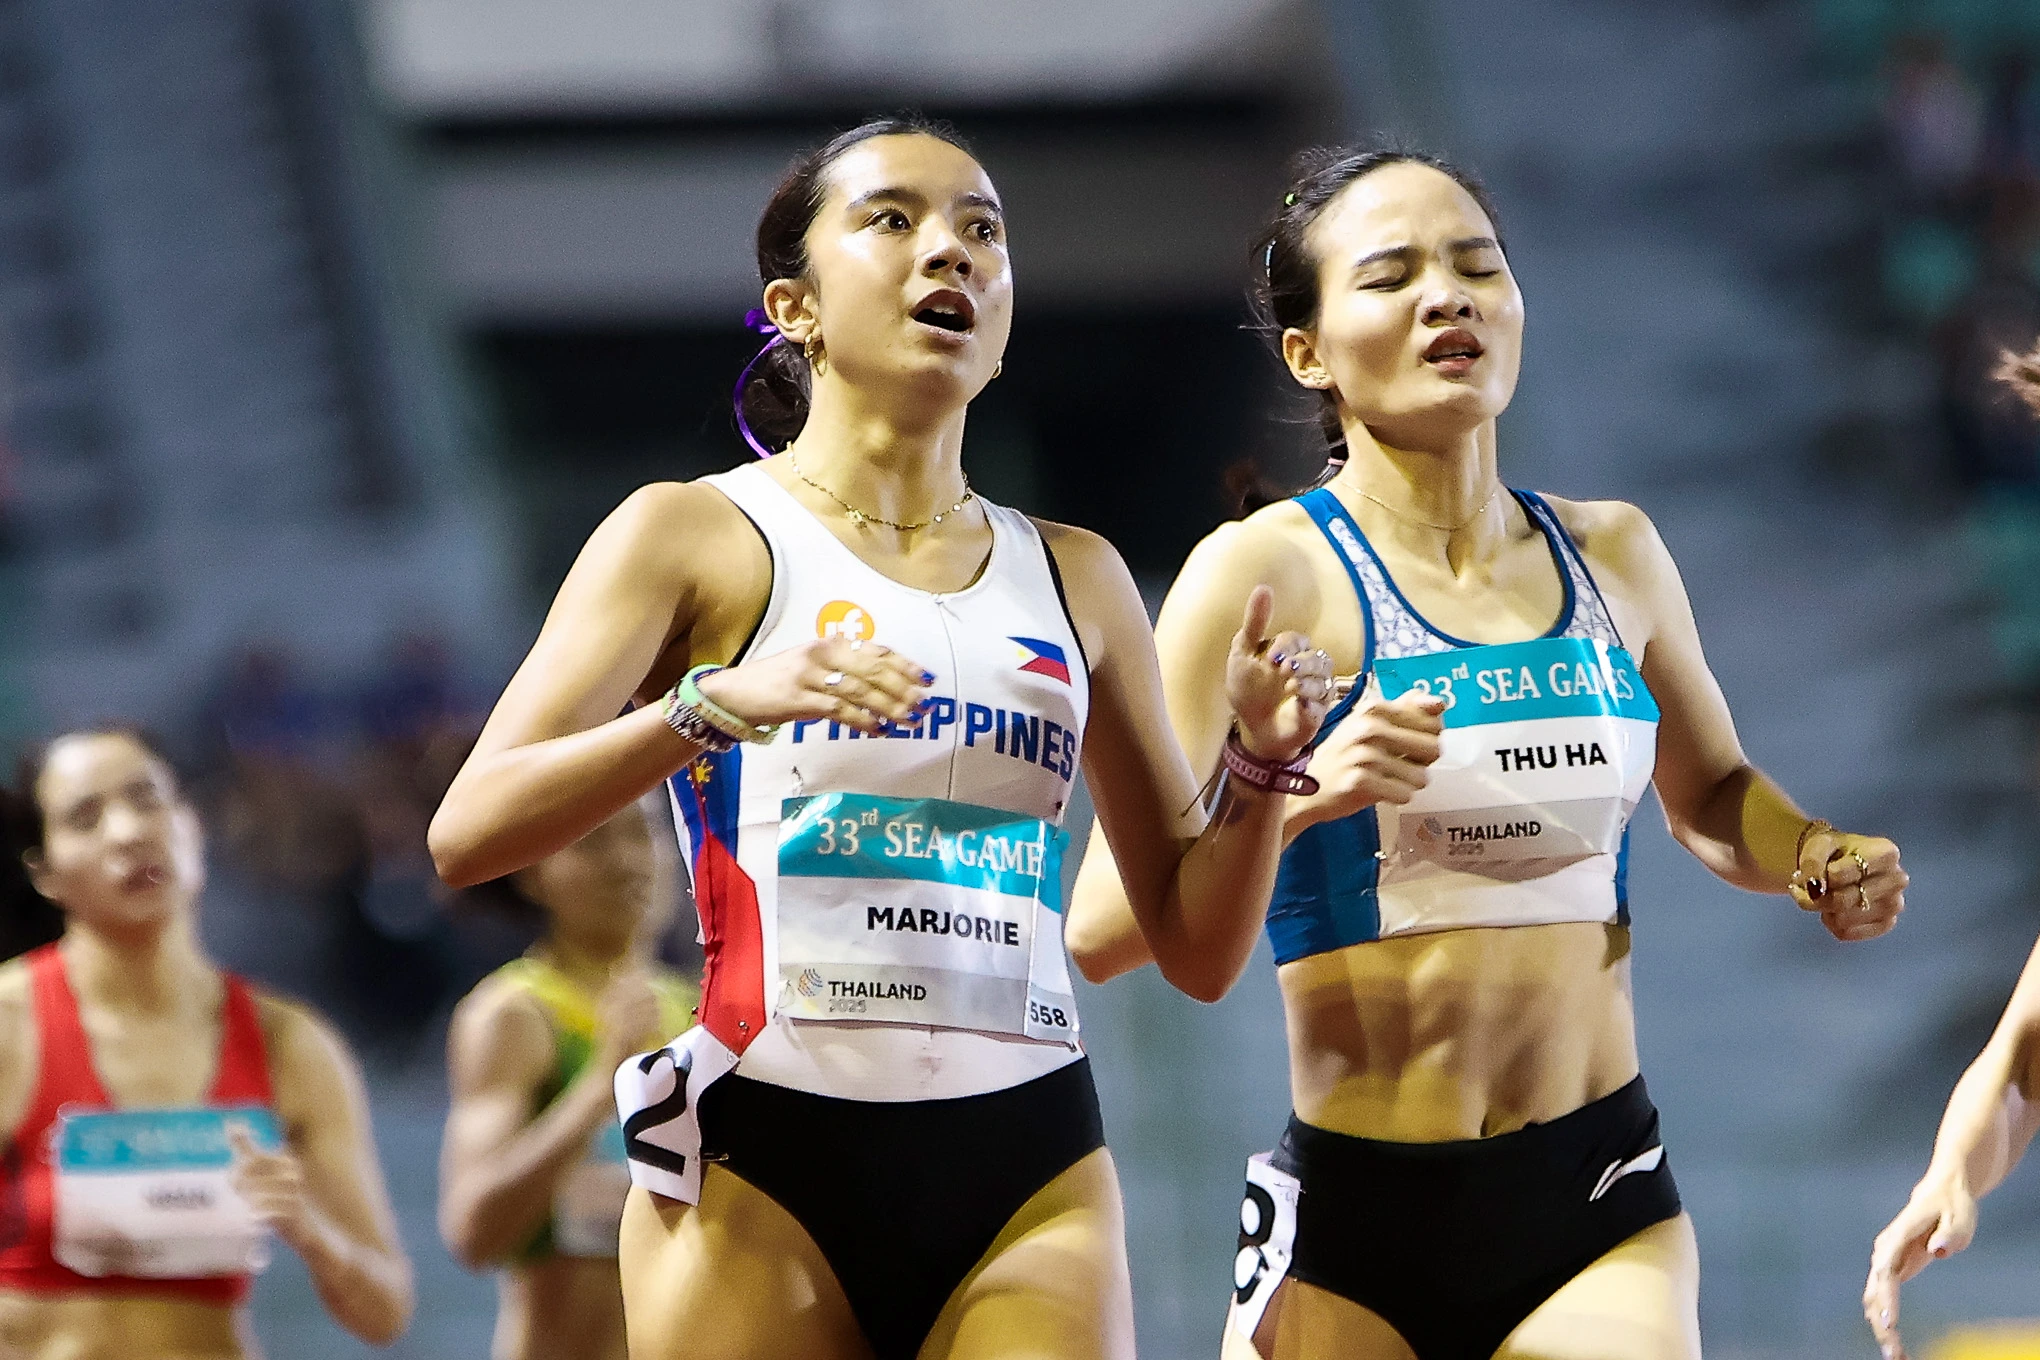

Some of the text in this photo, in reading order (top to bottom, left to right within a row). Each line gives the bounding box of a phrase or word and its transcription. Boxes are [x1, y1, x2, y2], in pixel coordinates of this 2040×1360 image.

[1476, 665, 1542, 704] SEA
[1494, 742, 1608, 772] THU HA
[816, 808, 880, 856] 33rd
[884, 821, 947, 860] SEA
[1447, 821, 1542, 842] THAILAND
[867, 906, 1020, 946] MARJORIE
[827, 981, 928, 1001] THAILAND
[1029, 1000, 1068, 1028] 558
[623, 1047, 693, 1177] 2
